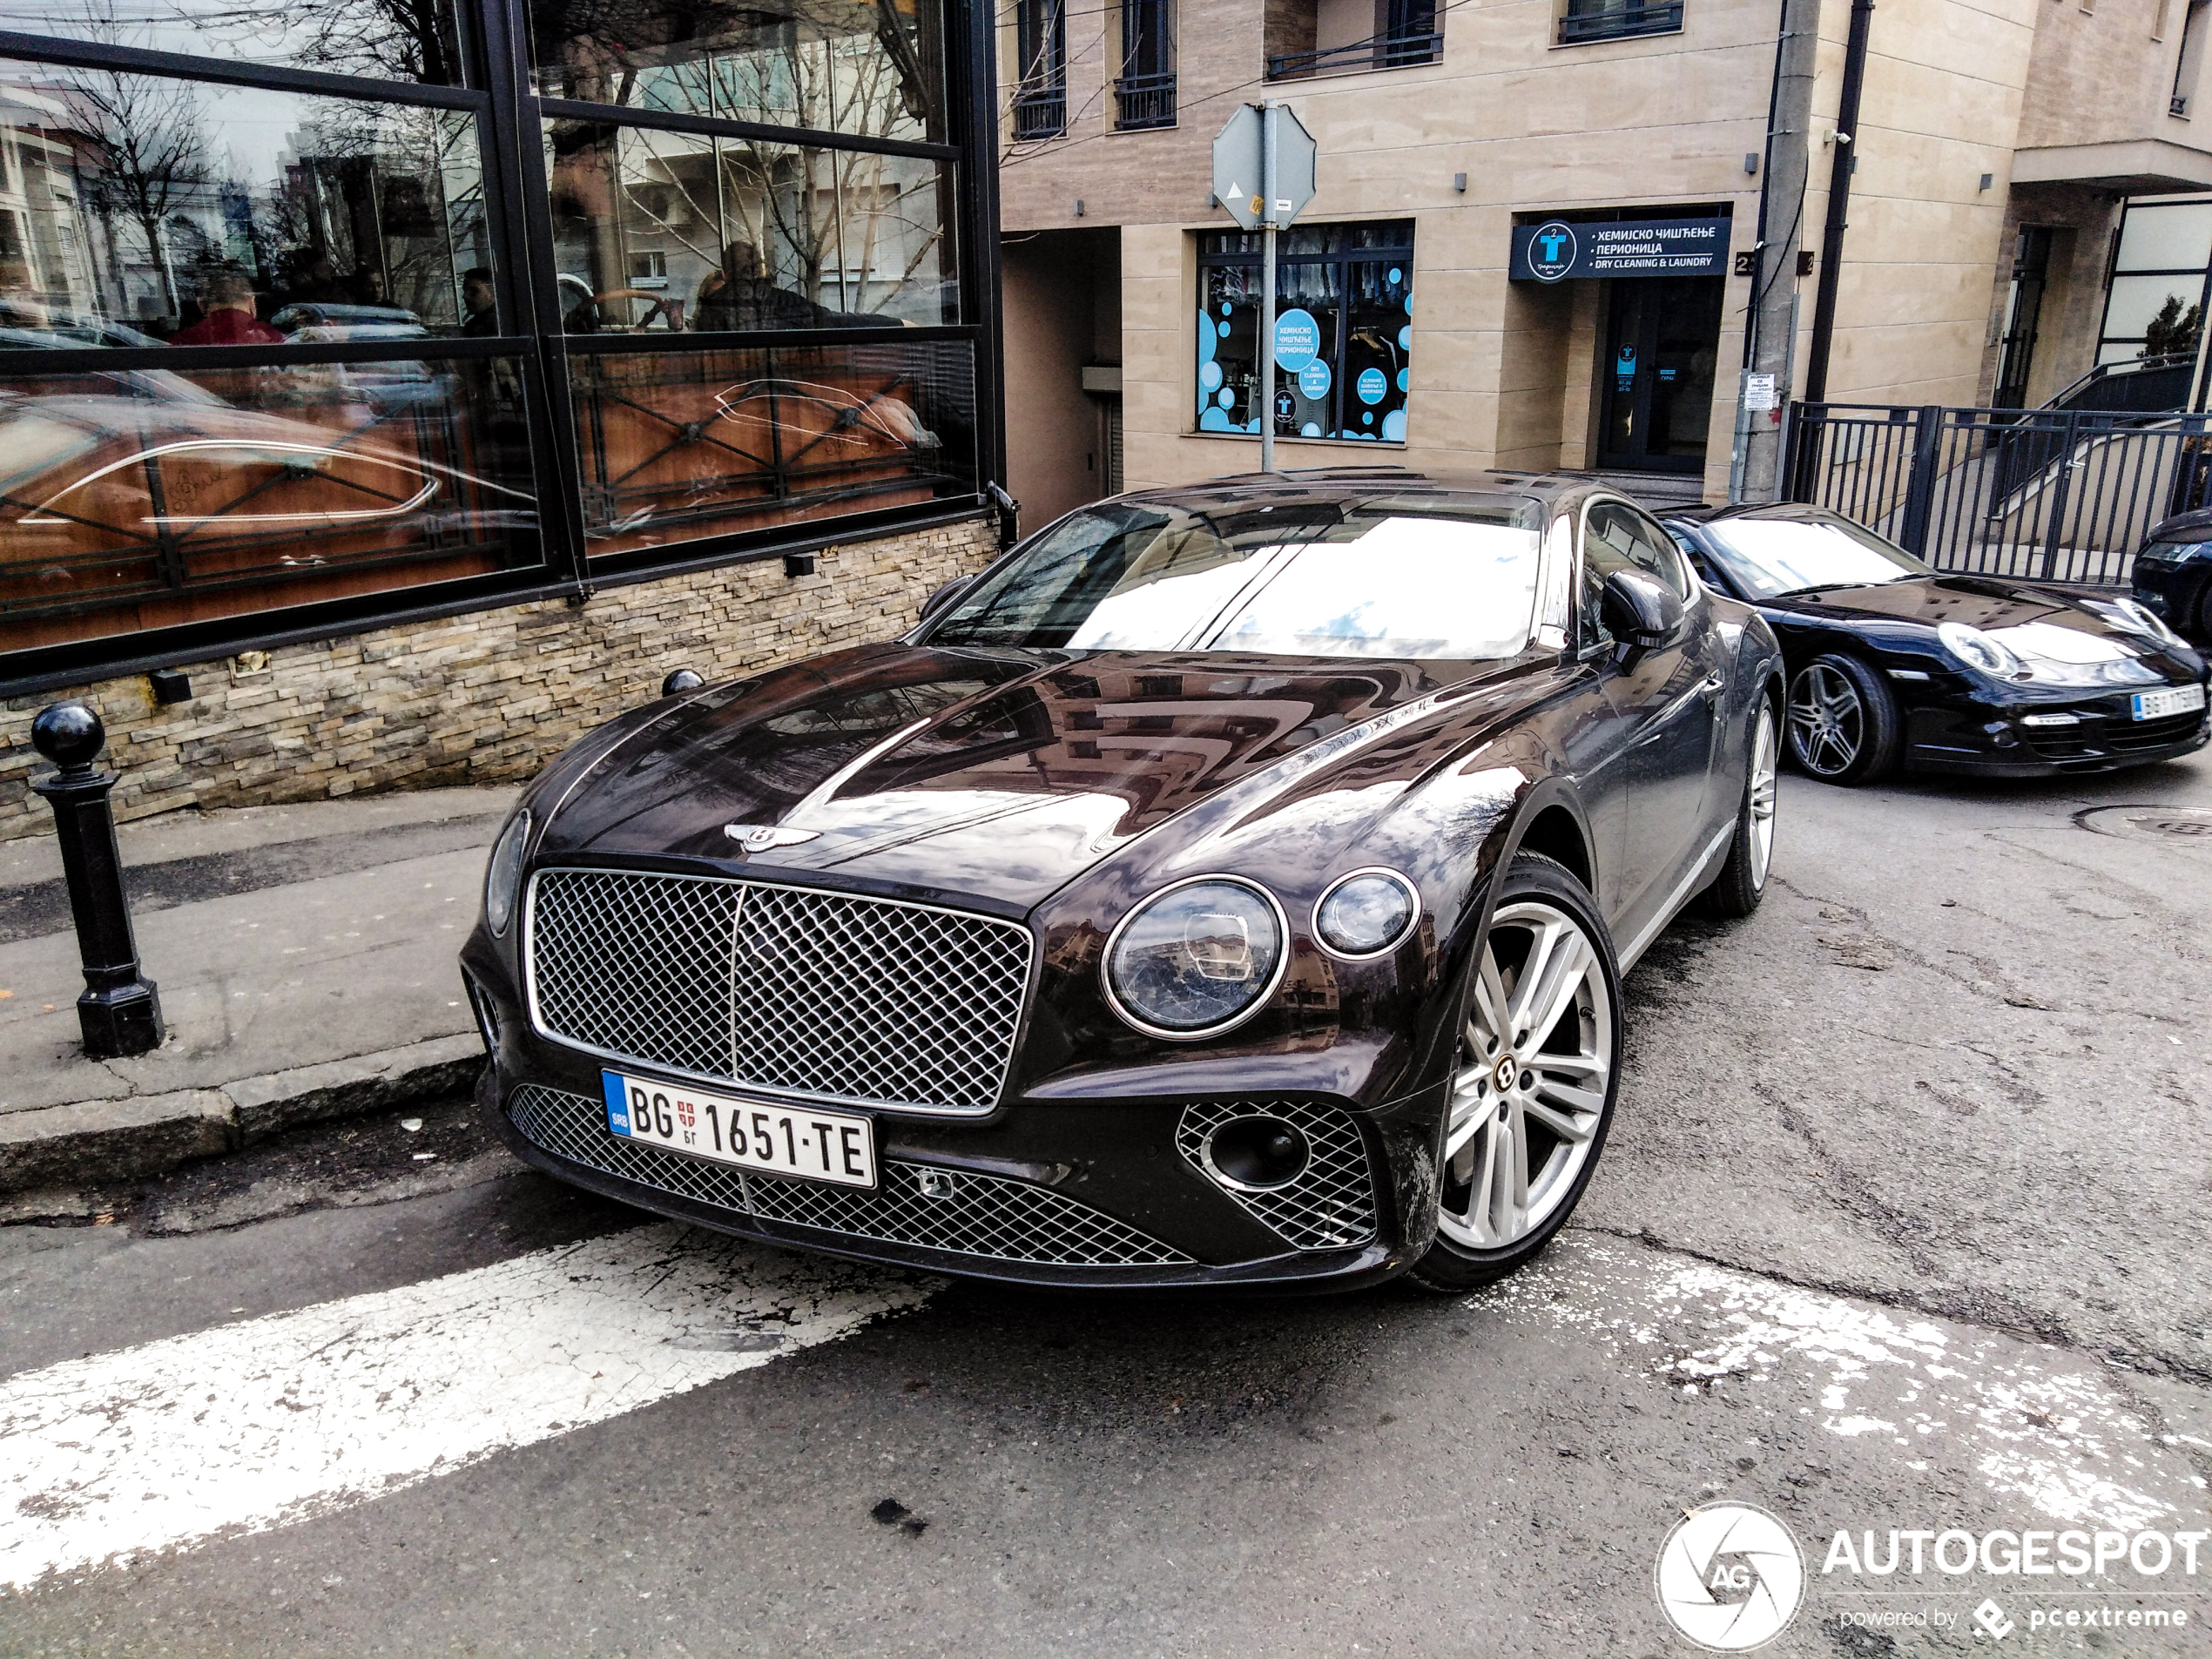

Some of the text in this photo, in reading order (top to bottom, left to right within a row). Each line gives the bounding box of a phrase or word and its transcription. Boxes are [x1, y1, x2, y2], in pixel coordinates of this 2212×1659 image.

[1597, 226, 1716, 241] ХЕМИЈСКО ЧИШЋЕЊЕ
[1596, 243, 1662, 255] ПЕРИОНИЦА
[1595, 257, 1713, 269] DRY CLEANING & LAUNDRY
[1736, 256, 1749, 272] 2
[630, 1086, 673, 1139] BG
[611, 1112, 629, 1129] SRB
